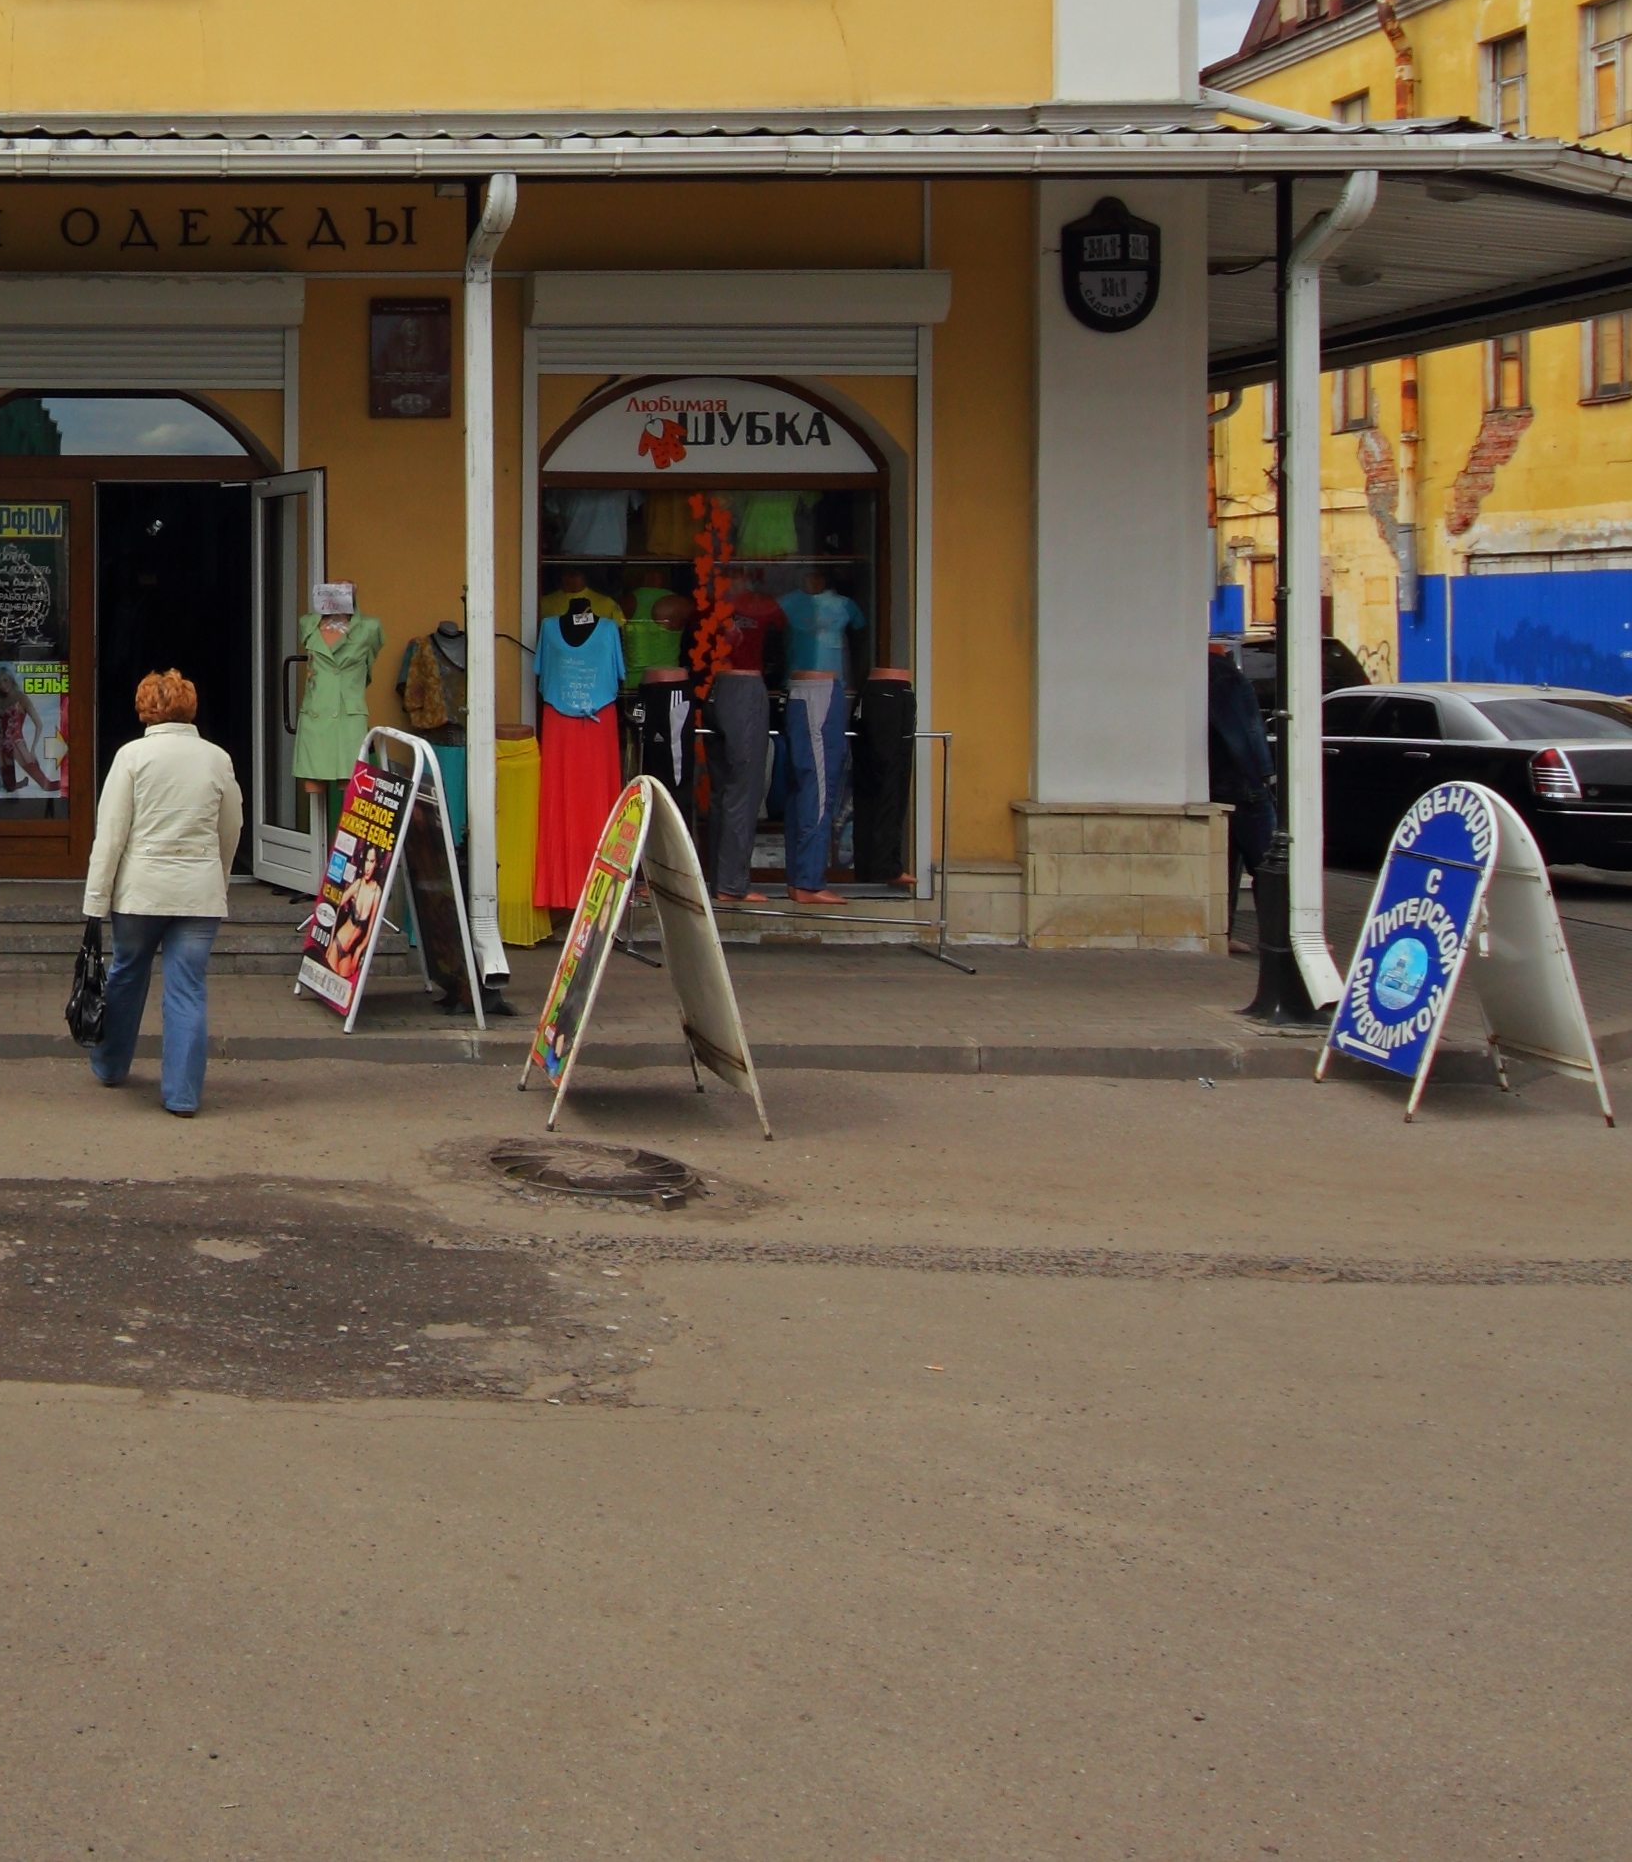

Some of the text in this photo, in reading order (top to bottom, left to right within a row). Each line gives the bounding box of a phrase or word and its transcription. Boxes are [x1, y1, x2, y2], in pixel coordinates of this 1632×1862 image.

[60, 205, 418, 252] ОДЕЖДЫ
[1084, 289, 1132, 315] САДОВАЯ
[625, 396, 728, 413] Любимая
[677, 411, 831, 447] ШУБКА
[350, 795, 395, 829] ЖЕНСКОЕ
[1396, 786, 1493, 862] СУВЕНИРЫ
[339, 810, 369, 841] НИЖНЕЕ
[367, 821, 395, 852] БЕЛЬЕ
[1426, 869, 1443, 895] С
[1352, 957, 1446, 1050] СИМВОЛИКОЙ
